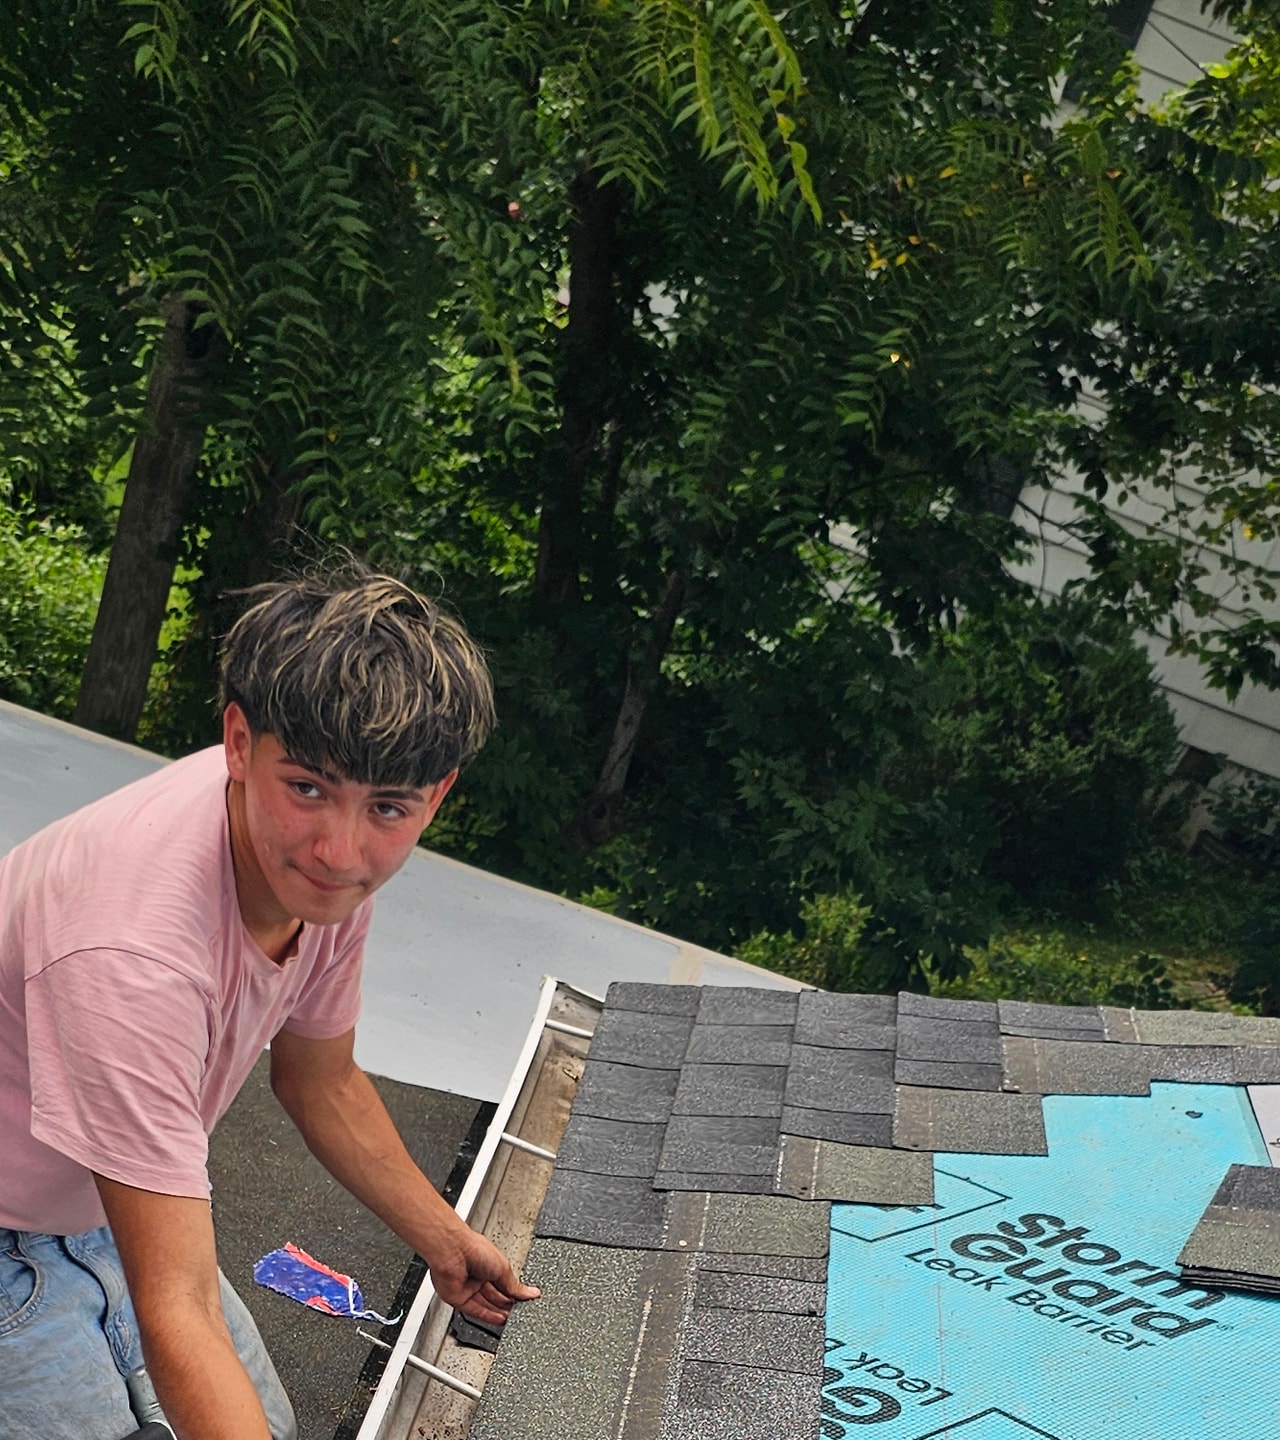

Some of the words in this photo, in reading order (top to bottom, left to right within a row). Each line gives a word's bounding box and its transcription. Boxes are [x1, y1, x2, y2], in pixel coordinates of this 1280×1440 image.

[905, 1248, 1008, 1293] Leak
[1006, 1287, 1159, 1351] Barrier
[997, 1212, 1225, 1310] Storm
[841, 1352, 952, 1405] Leak
